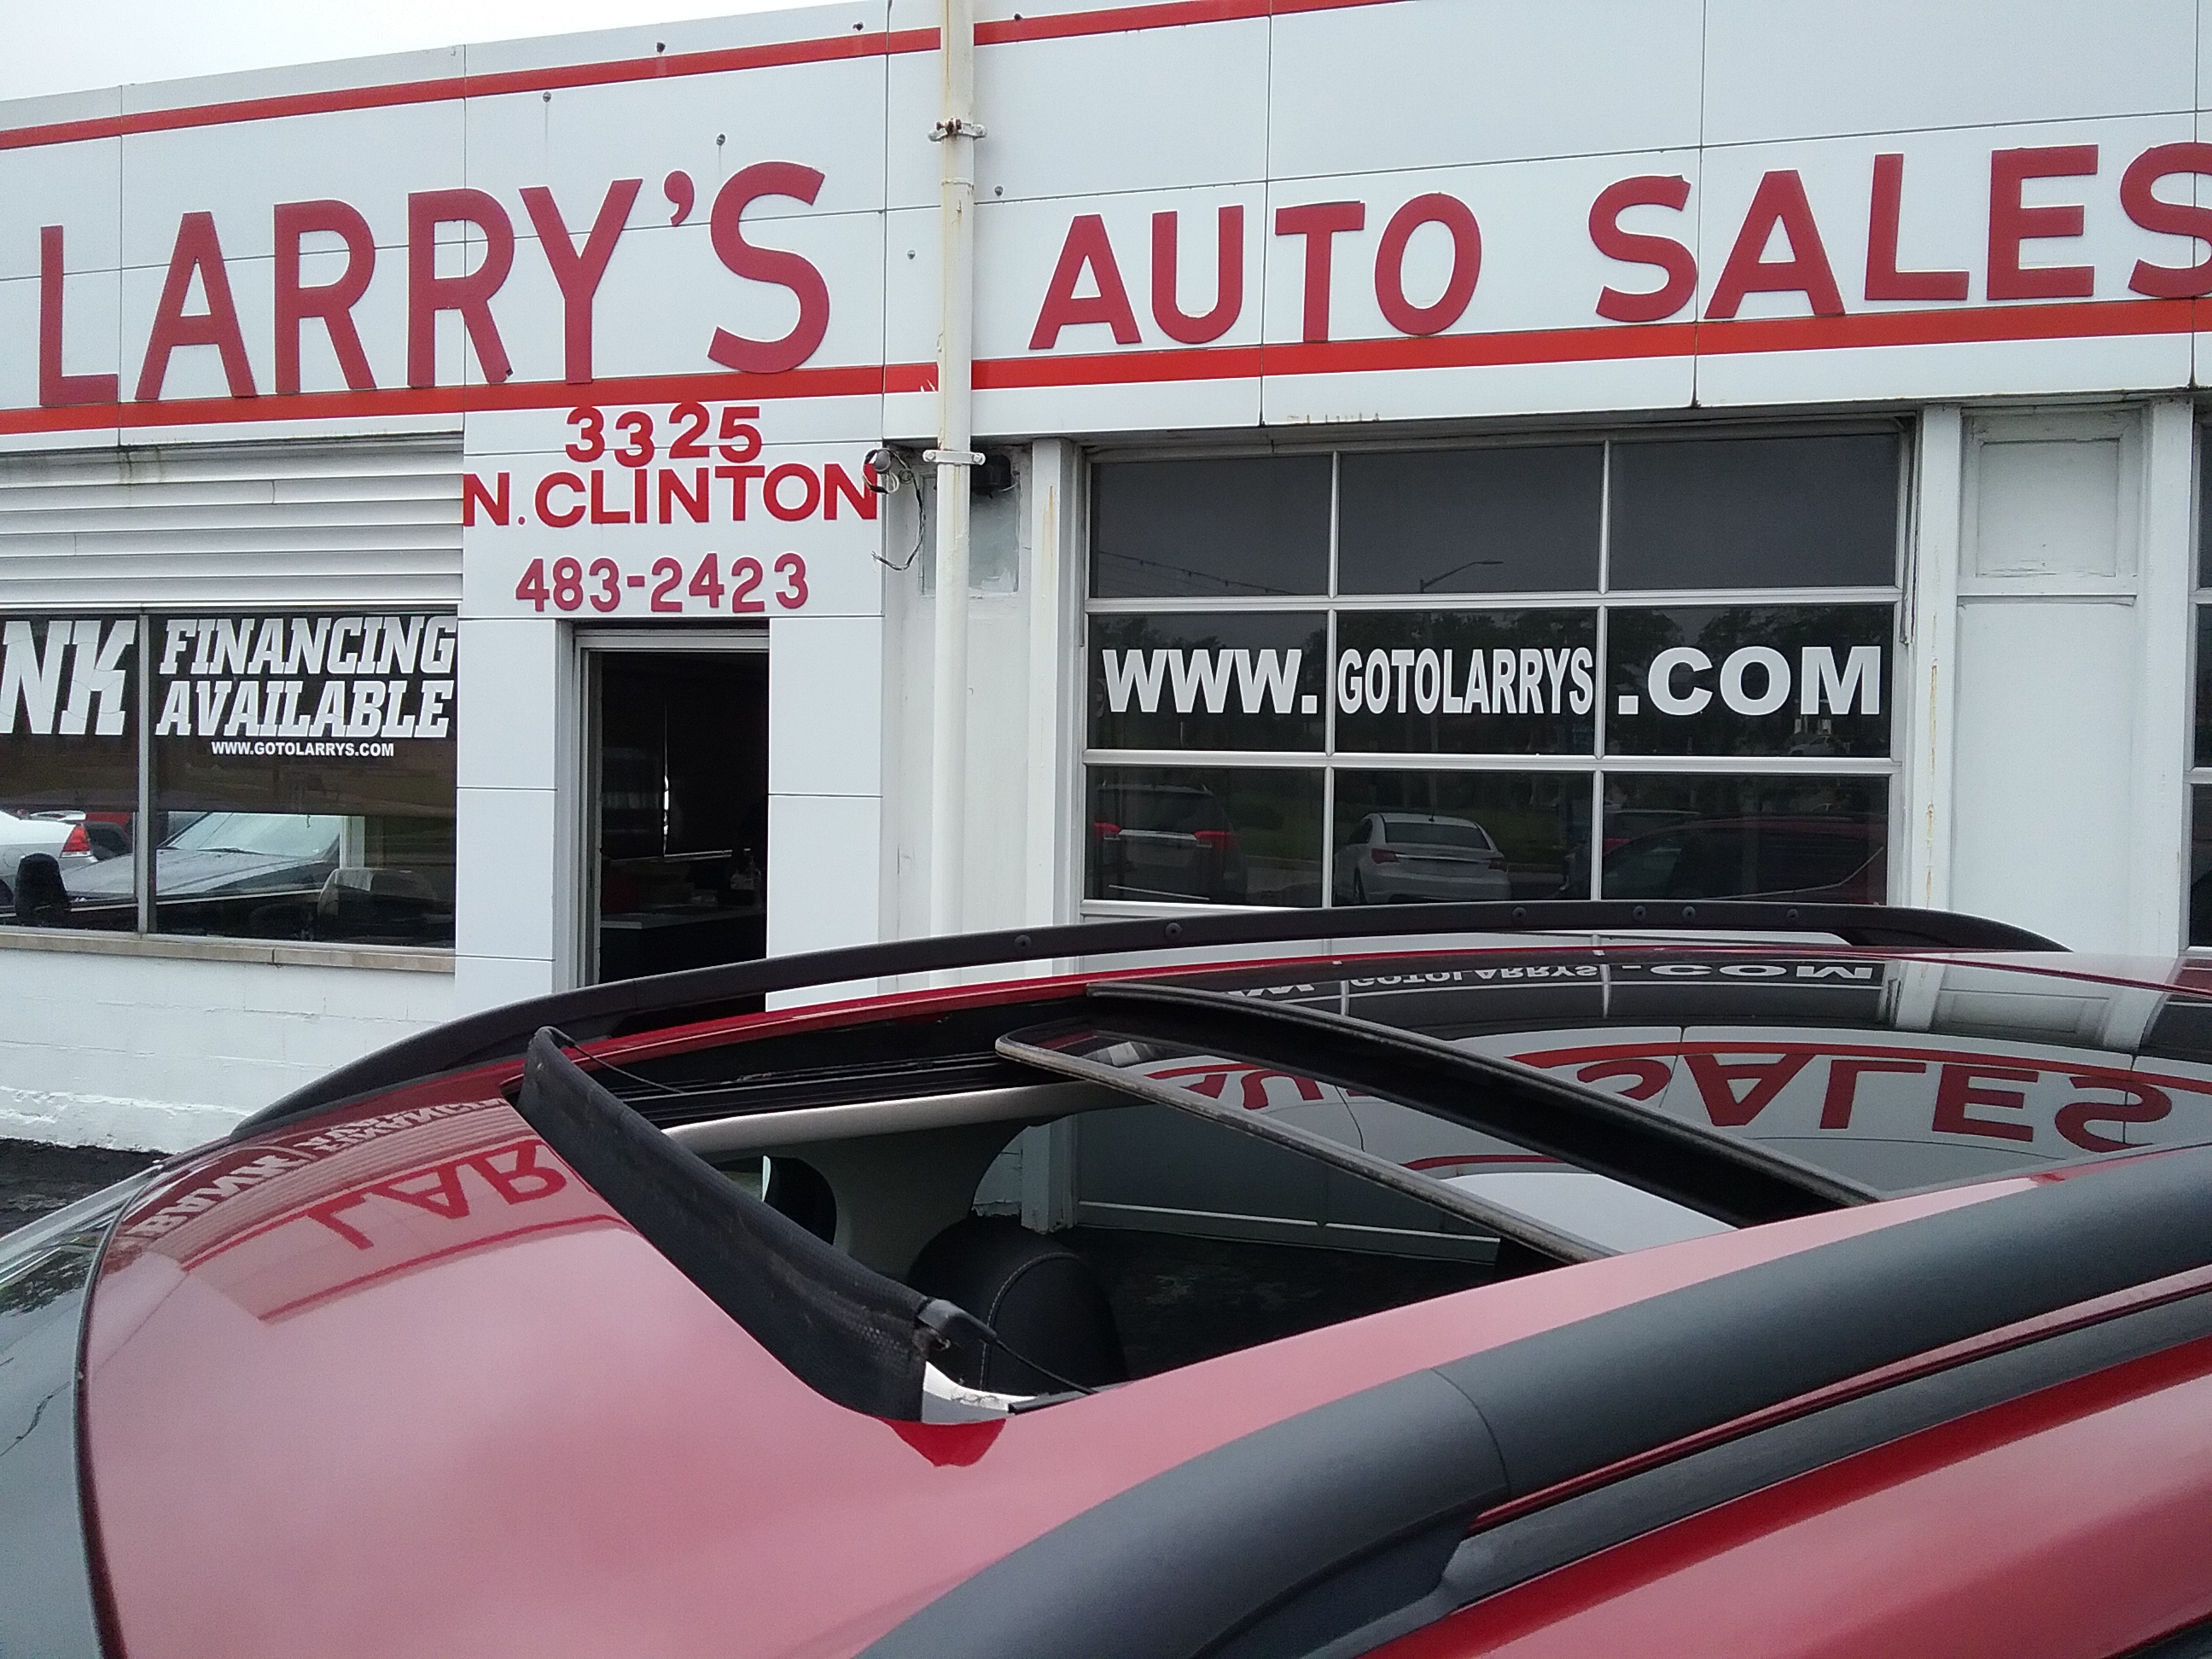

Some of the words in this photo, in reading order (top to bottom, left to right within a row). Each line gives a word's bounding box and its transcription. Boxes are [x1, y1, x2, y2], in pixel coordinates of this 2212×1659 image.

[38, 160, 830, 406] LARRY'S
[1028, 192, 1482, 350] AUTO
[1588, 142, 2212, 323] SALES
[564, 401, 763, 468] 3325
[515, 551, 809, 614] 483-2423
[159, 615, 458, 675] FINANCING
[154, 679, 456, 739] AVAILABLE
[1338, 647, 1594, 715] GOTOLARRYS
[211, 740, 395, 758] WWW.GOTOLARRYS.COM
